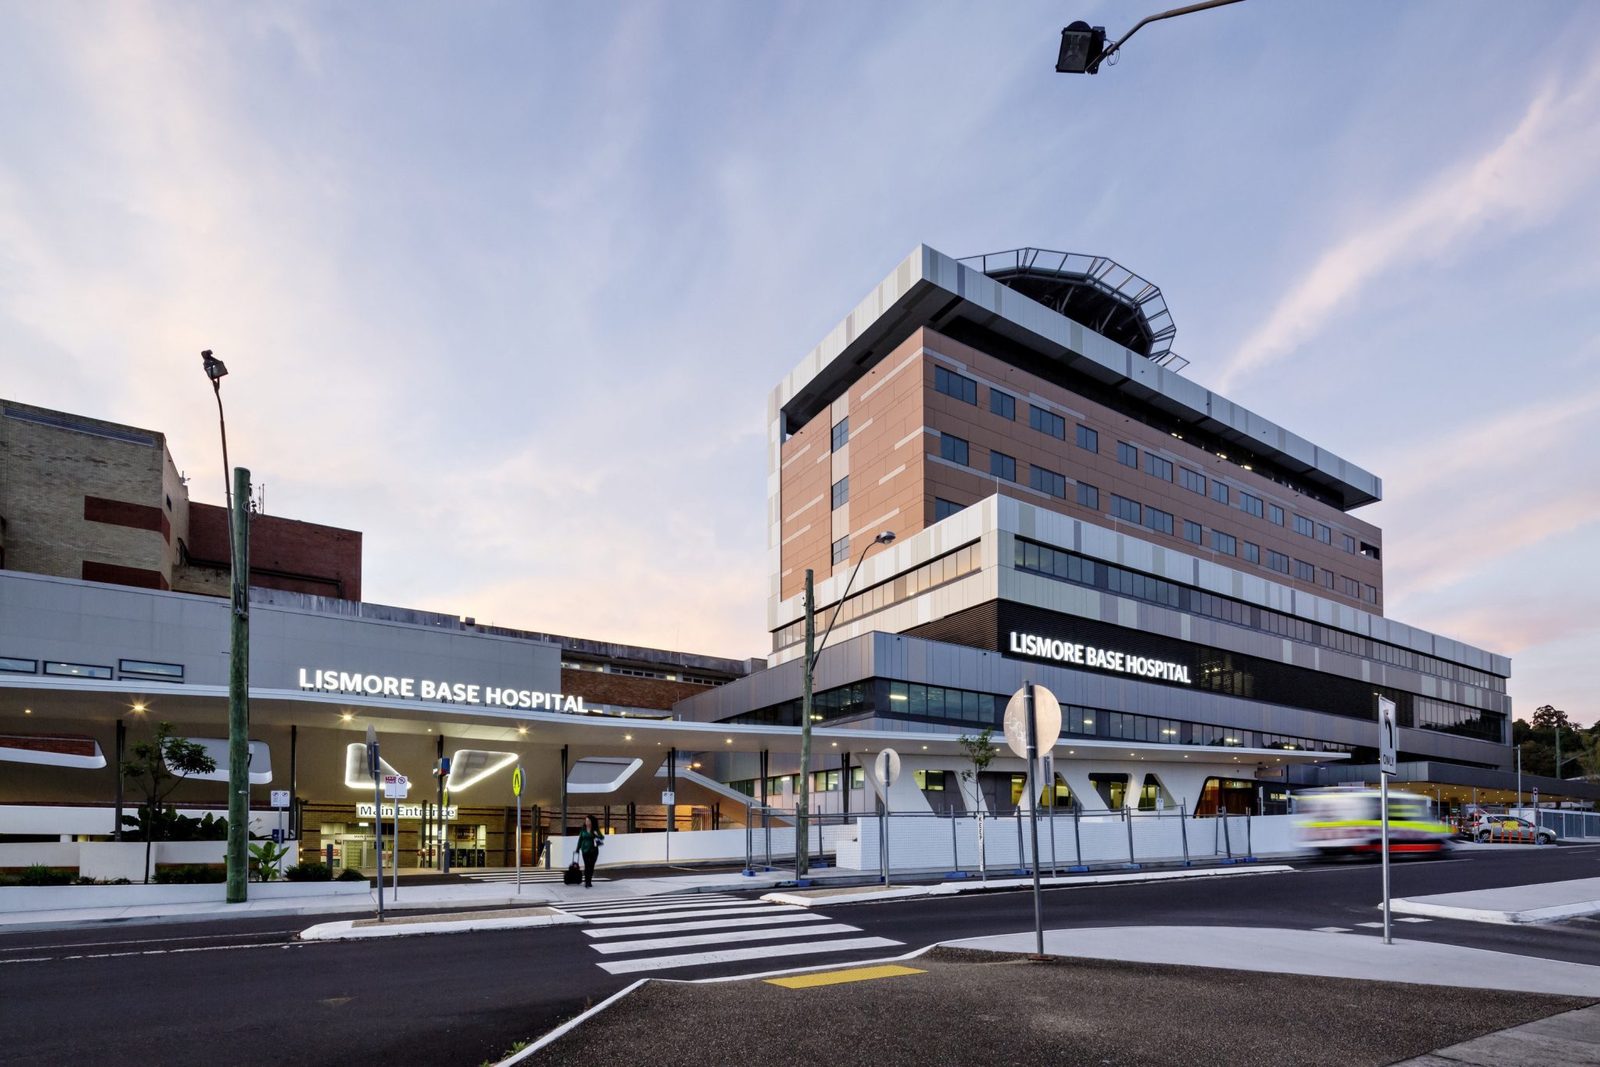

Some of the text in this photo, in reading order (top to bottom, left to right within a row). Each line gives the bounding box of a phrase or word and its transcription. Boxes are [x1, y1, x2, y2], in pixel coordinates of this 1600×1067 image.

[1010, 632, 1191, 683] LISMORE BASE HOSPITAL
[299, 668, 588, 713] LISMORE BASE HOSPITAL
